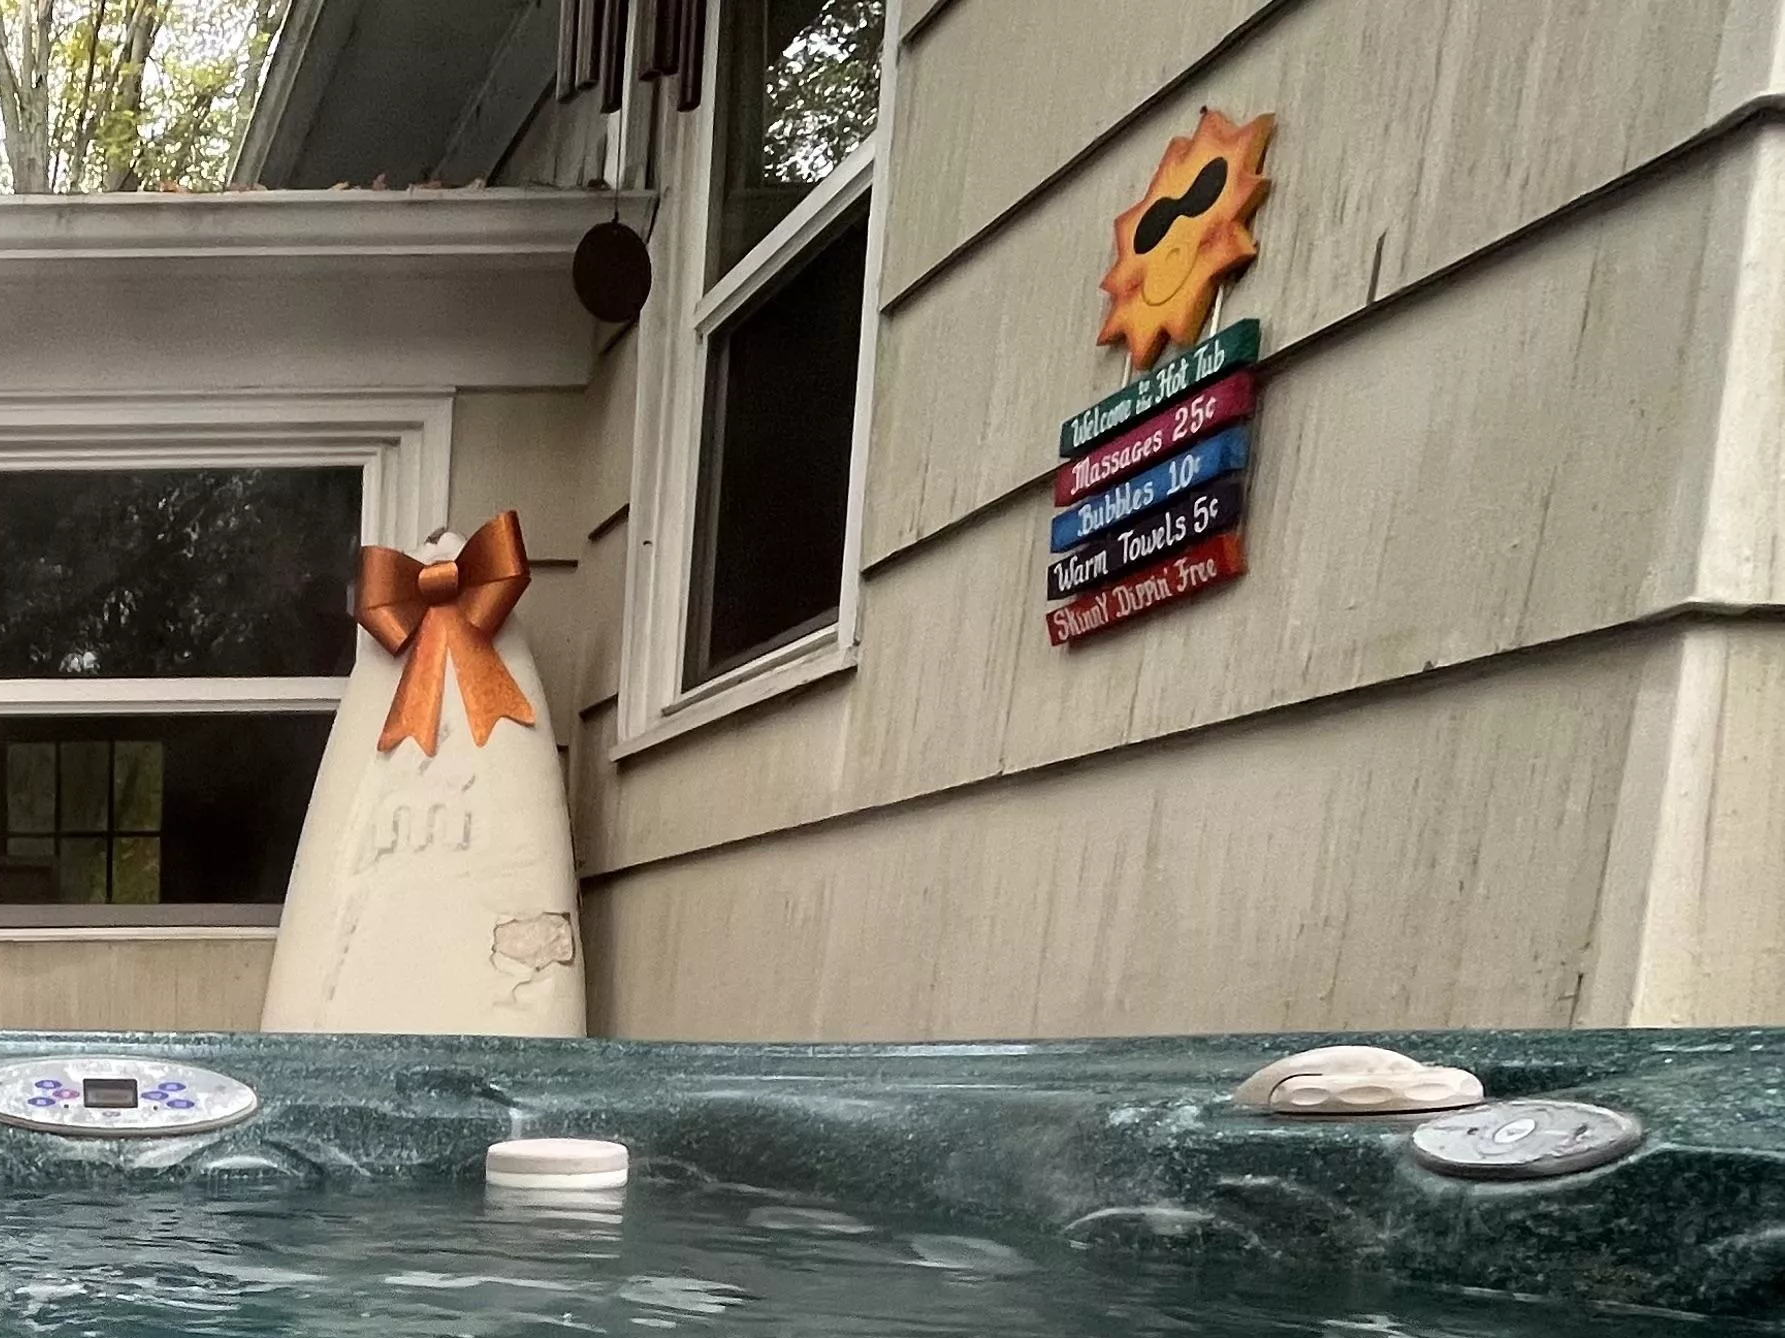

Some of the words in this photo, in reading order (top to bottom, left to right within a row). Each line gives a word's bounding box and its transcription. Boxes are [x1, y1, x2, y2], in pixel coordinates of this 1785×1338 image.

[1071, 399, 1132, 447] Welcome
[1155, 359, 1190, 404] Hot
[1194, 339, 1225, 381] Tub
[1077, 479, 1154, 537] Bubbles
[1053, 549, 1109, 592] Warm
[1117, 512, 1186, 564] Towels
[1173, 556, 1217, 592] Free
